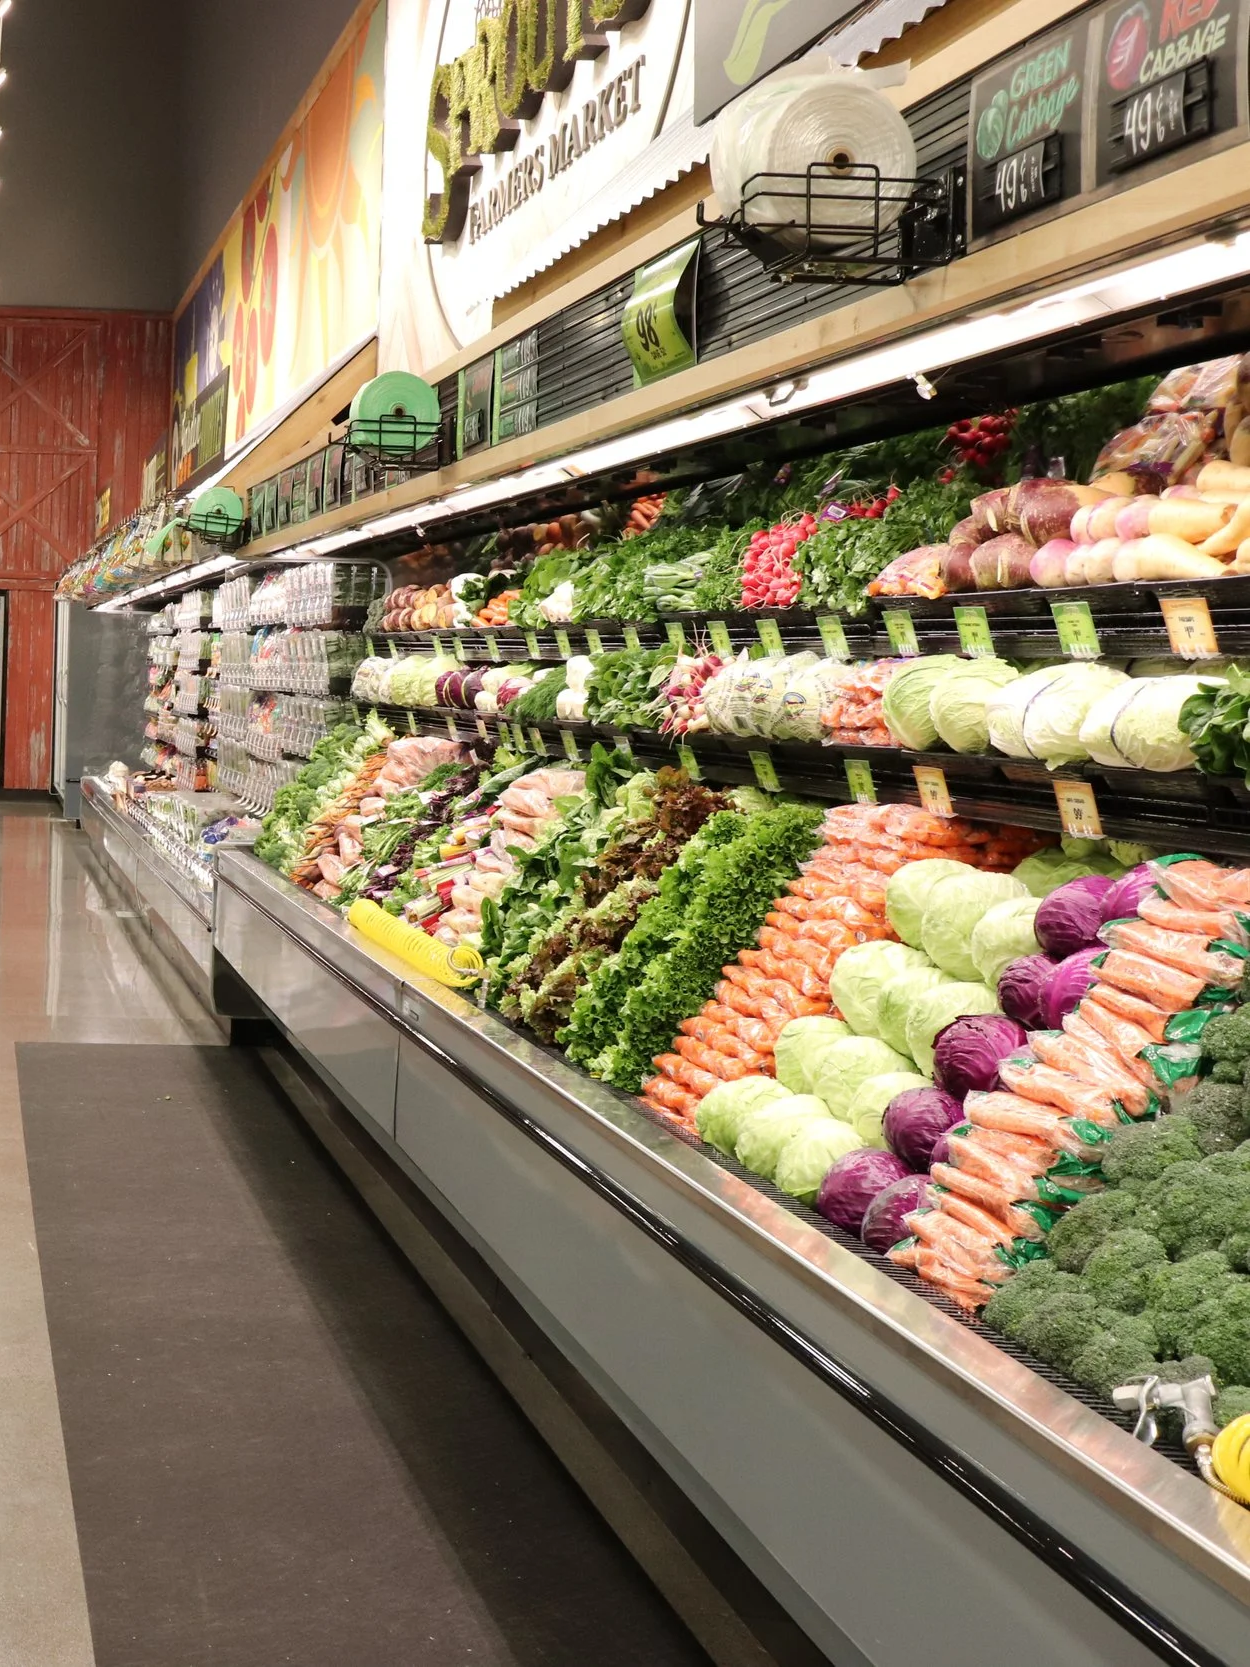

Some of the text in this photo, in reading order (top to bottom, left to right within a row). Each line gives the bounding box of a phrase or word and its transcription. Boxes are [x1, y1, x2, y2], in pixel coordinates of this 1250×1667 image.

[1010, 38, 1073, 99] GREEN
[1139, 13, 1230, 83] CABBAGE
[422, 0, 632, 240] SPROU
[469, 54, 646, 244] FARMERS MARKET
[1006, 75, 1080, 151] Cabbage
